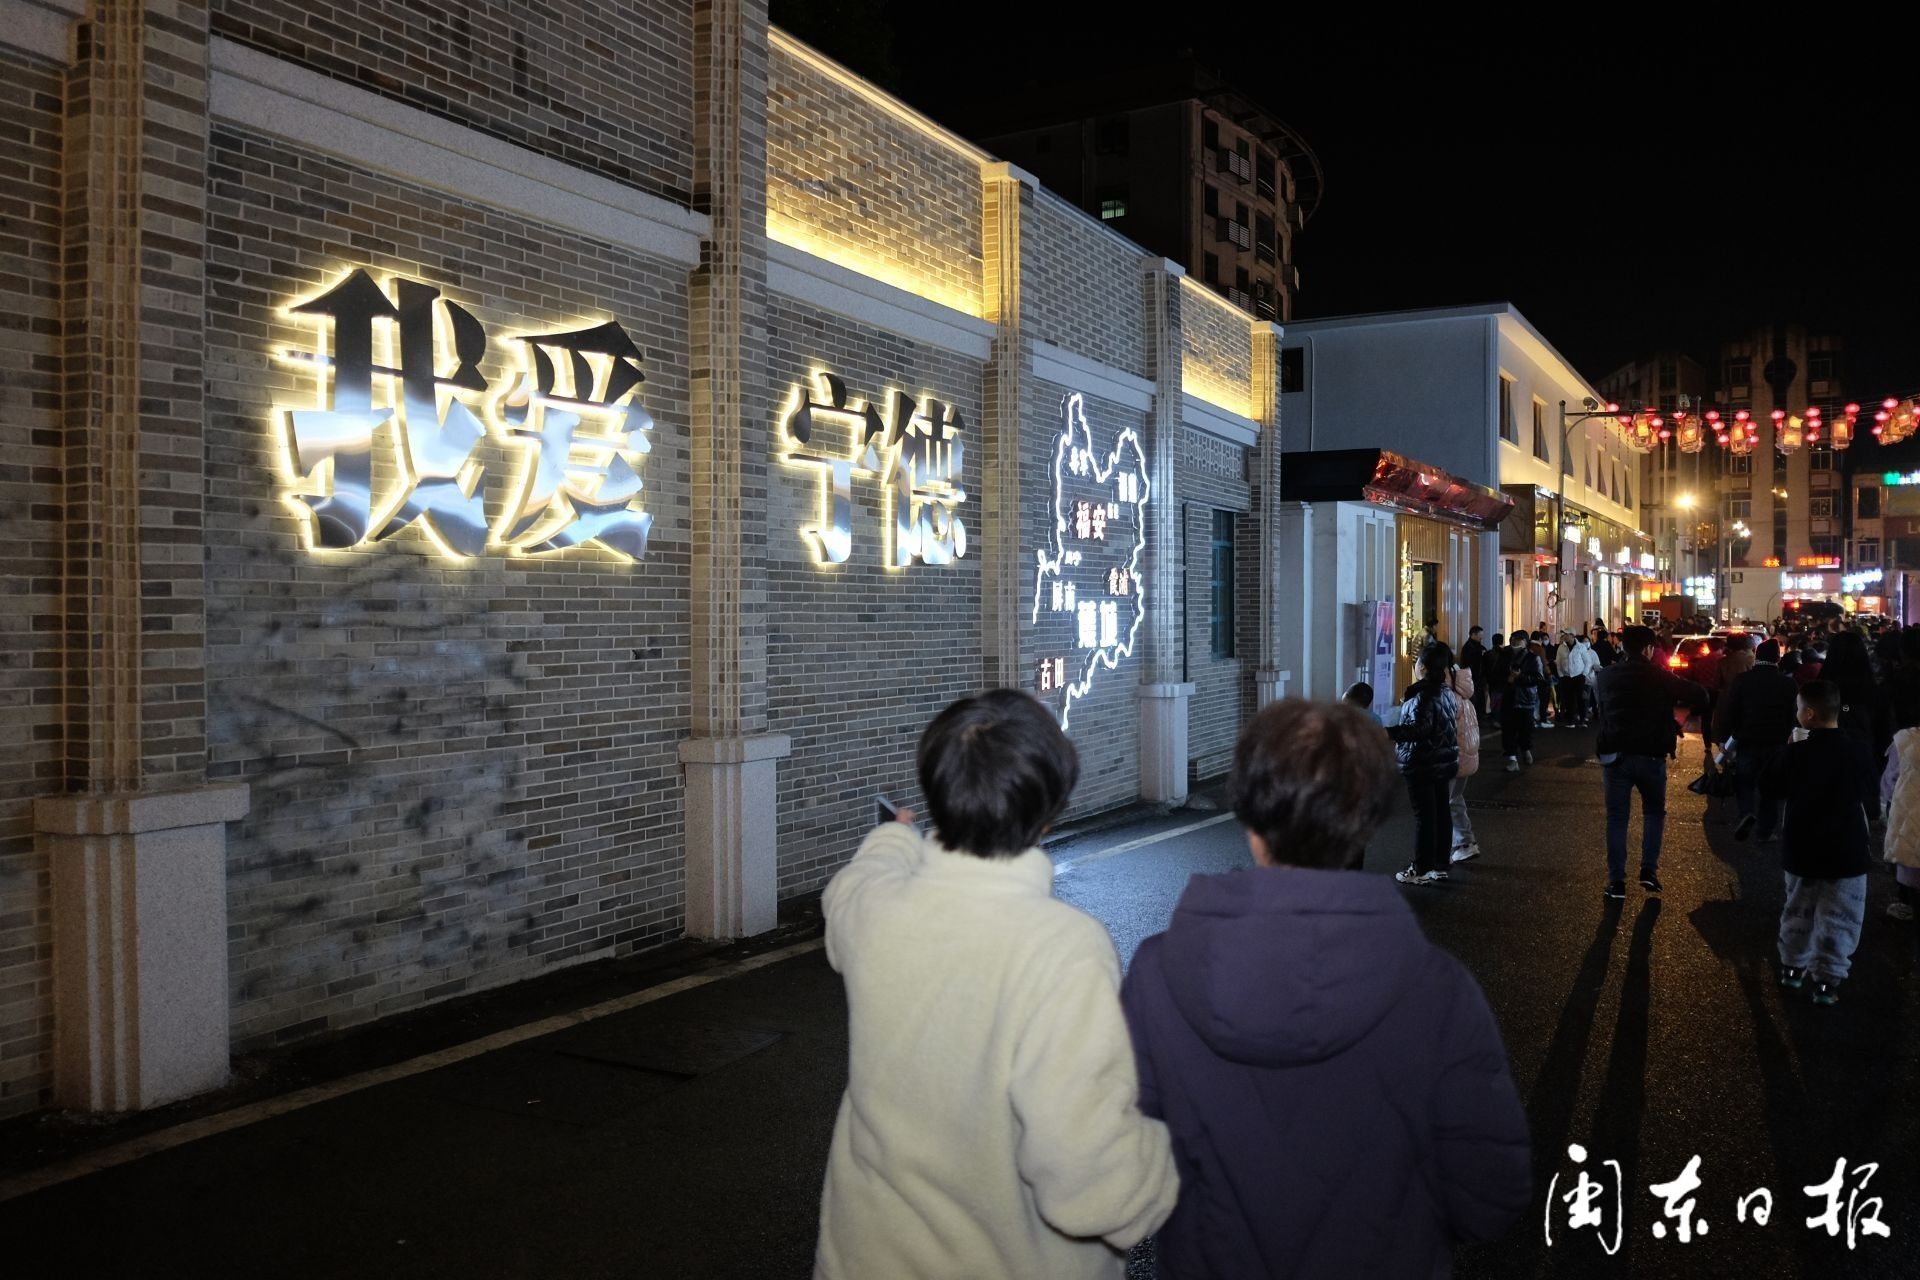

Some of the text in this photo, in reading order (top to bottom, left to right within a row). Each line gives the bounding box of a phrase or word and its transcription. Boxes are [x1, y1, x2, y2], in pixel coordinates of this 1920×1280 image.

[283, 268, 967, 567] 我爱 宁德
[1076, 500, 1106, 540] 福安
[1040, 657, 1064, 691] 古田
